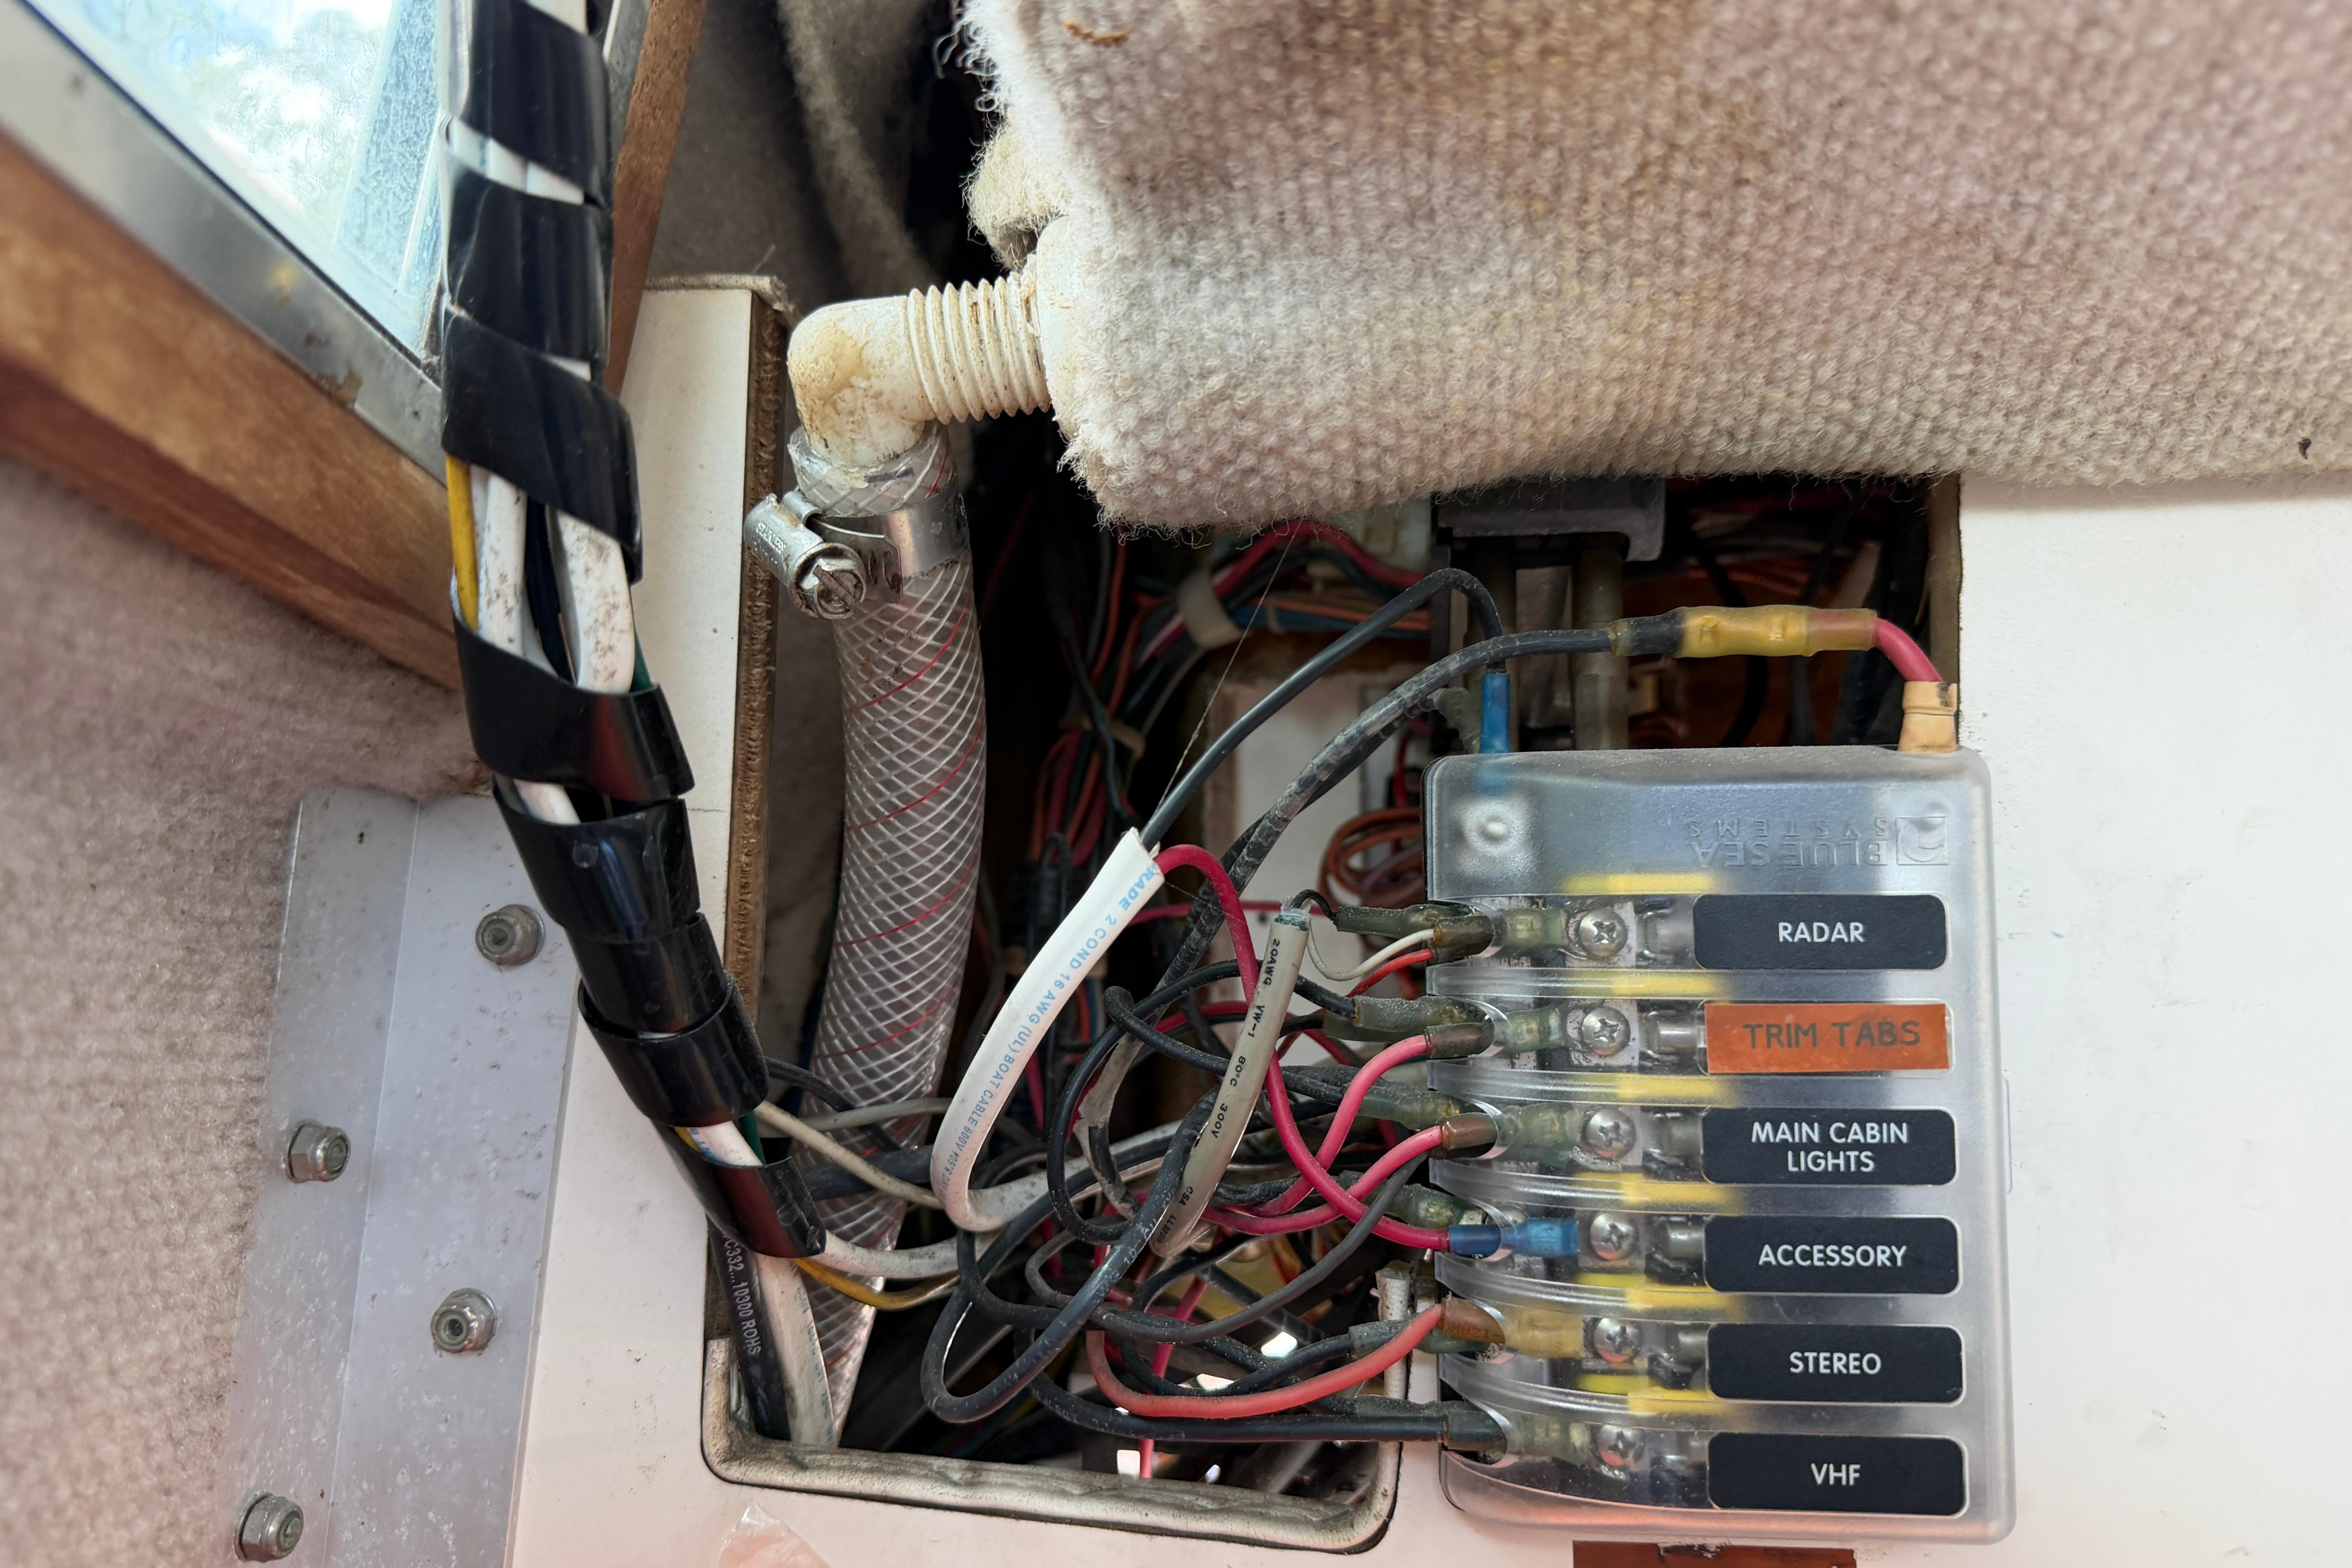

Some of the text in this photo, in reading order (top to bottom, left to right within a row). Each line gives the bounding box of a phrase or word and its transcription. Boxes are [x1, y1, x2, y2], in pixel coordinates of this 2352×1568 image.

[1688, 817, 1888, 838] SYSTEMS
[1690, 840, 1888, 867] BLUE SEA
[1119, 862, 1159, 911] RADE
[1105, 915, 1117, 926] 2
[1778, 921, 1865, 943] RADAR
[1070, 928, 1107, 969] COND
[1262, 938, 1281, 986] 20AWG
[1054, 973, 1070, 989] 16
[1029, 989, 1055, 1024] AWG
[1248, 1005, 1265, 1038] VW-1
[1743, 1020, 1920, 1048] TRIM TABS
[1008, 1024, 1032, 1054] (UL)
[990, 1054, 1015, 1089] BOAT
[1230, 1055, 1246, 1087] 80°C
[968, 1090, 993, 1127] CABLE
[1211, 1103, 1228, 1139] 300V
[955, 1127, 973, 1152] 600V
[1752, 1122, 1907, 1143] MAIN CABIN
[1788, 1151, 1874, 1172] LIGHTS
[1179, 1186, 1194, 1206] CSA
[1758, 1244, 1907, 1267] ACCESSORY
[732, 1281, 754, 1317] 10300
[741, 1318, 762, 1355] ROHS
[1790, 1351, 1881, 1374] STEREO
[1811, 1463, 1860, 1485] VHF
